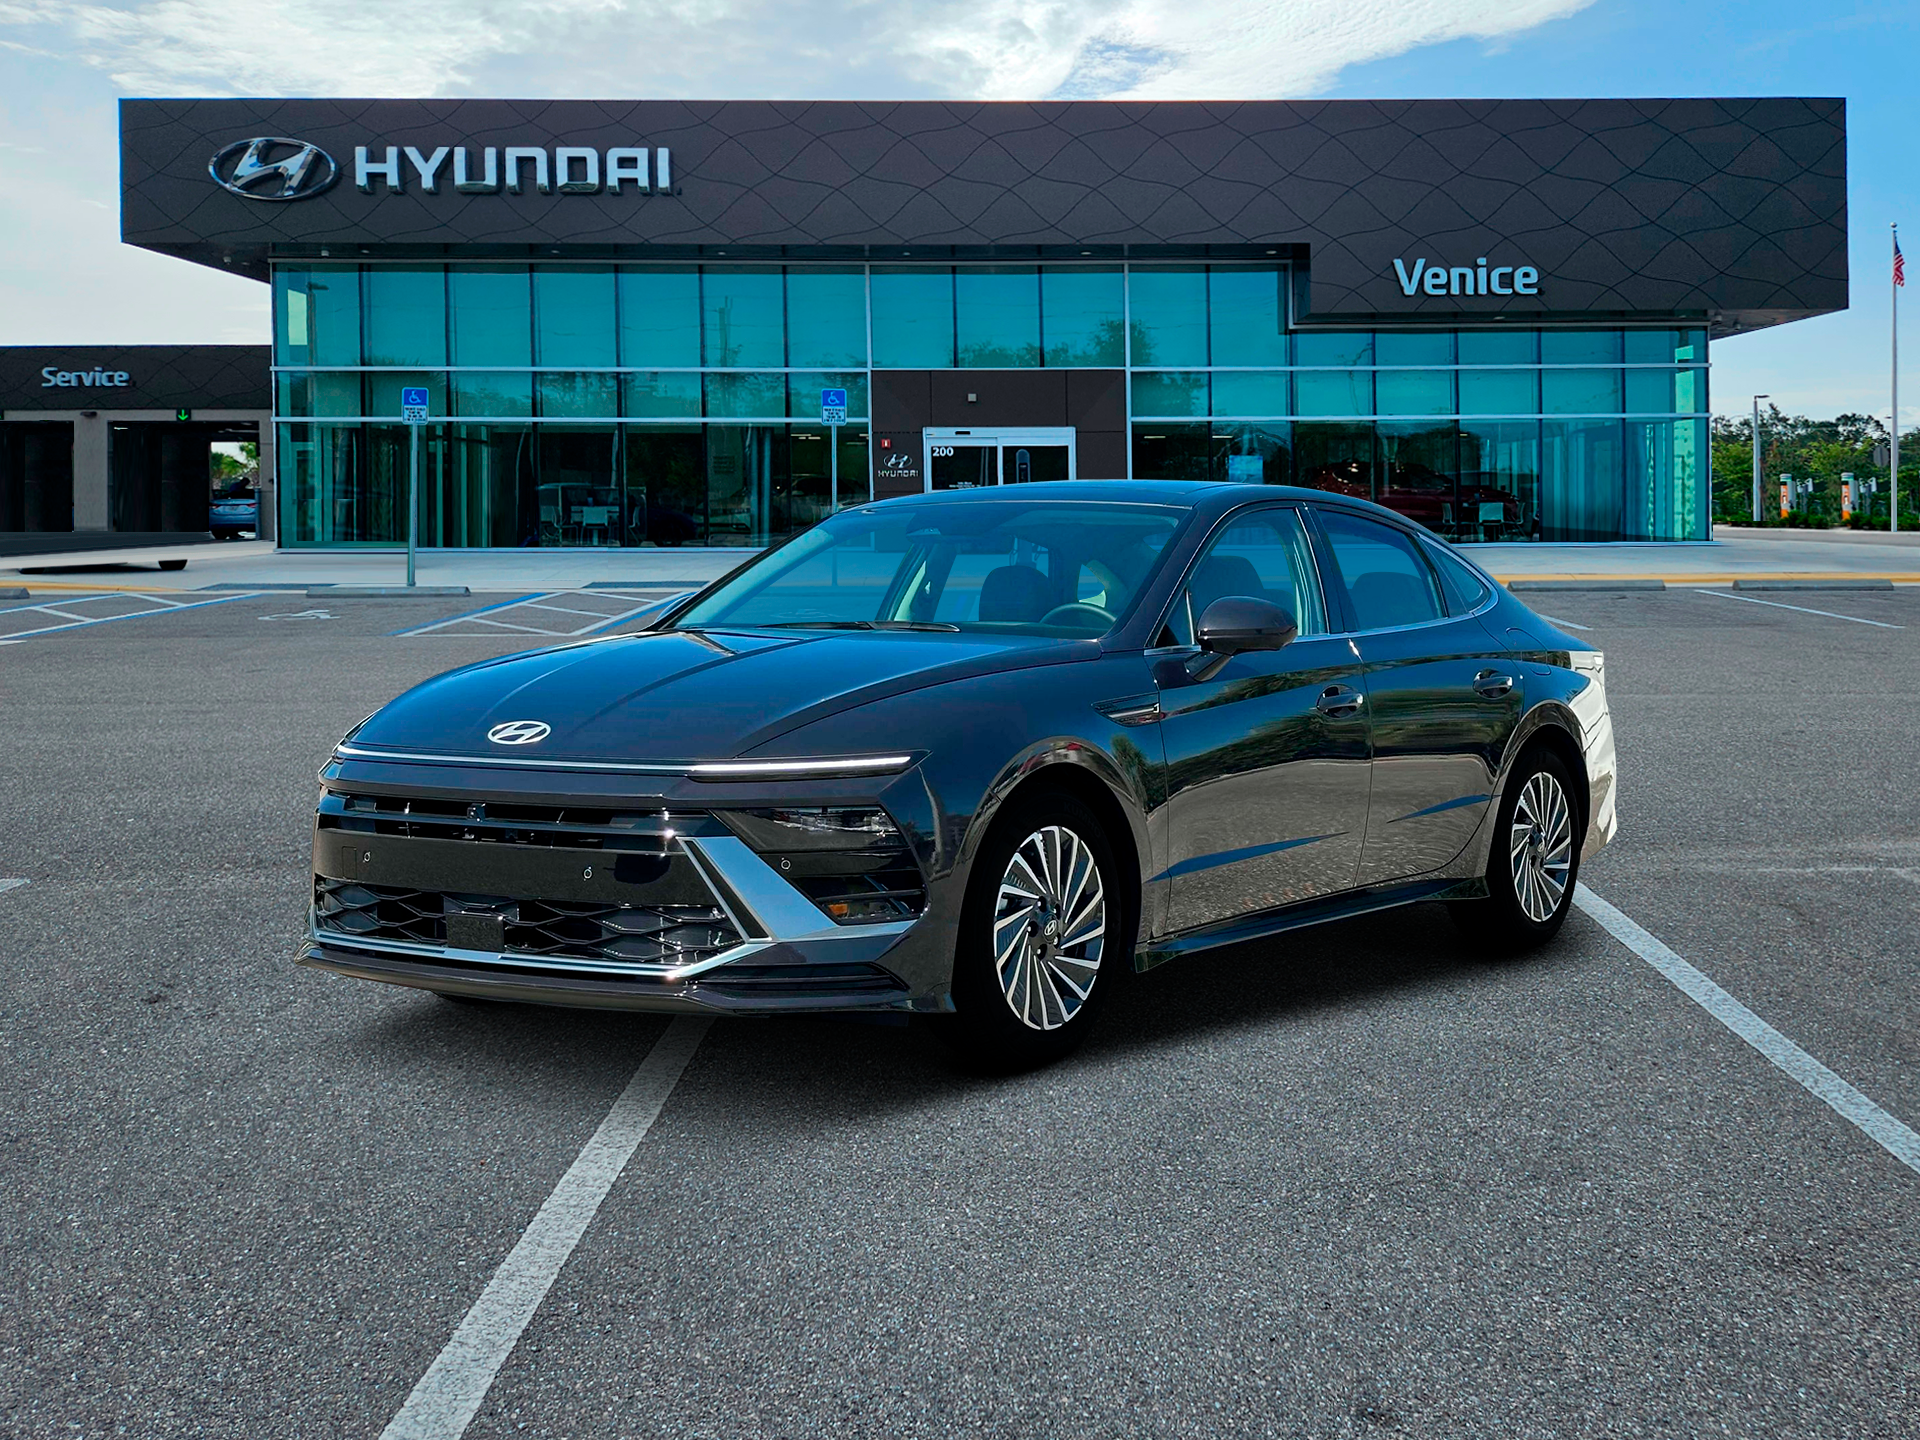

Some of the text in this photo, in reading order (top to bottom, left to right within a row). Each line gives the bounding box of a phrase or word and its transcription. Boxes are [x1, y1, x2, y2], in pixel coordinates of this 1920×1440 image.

[354, 146, 670, 195] HYUNDAI
[1393, 257, 1539, 296] Venice
[41, 366, 130, 387] Service
[932, 447, 954, 457] 200
[877, 469, 919, 478] HYUNDAI
